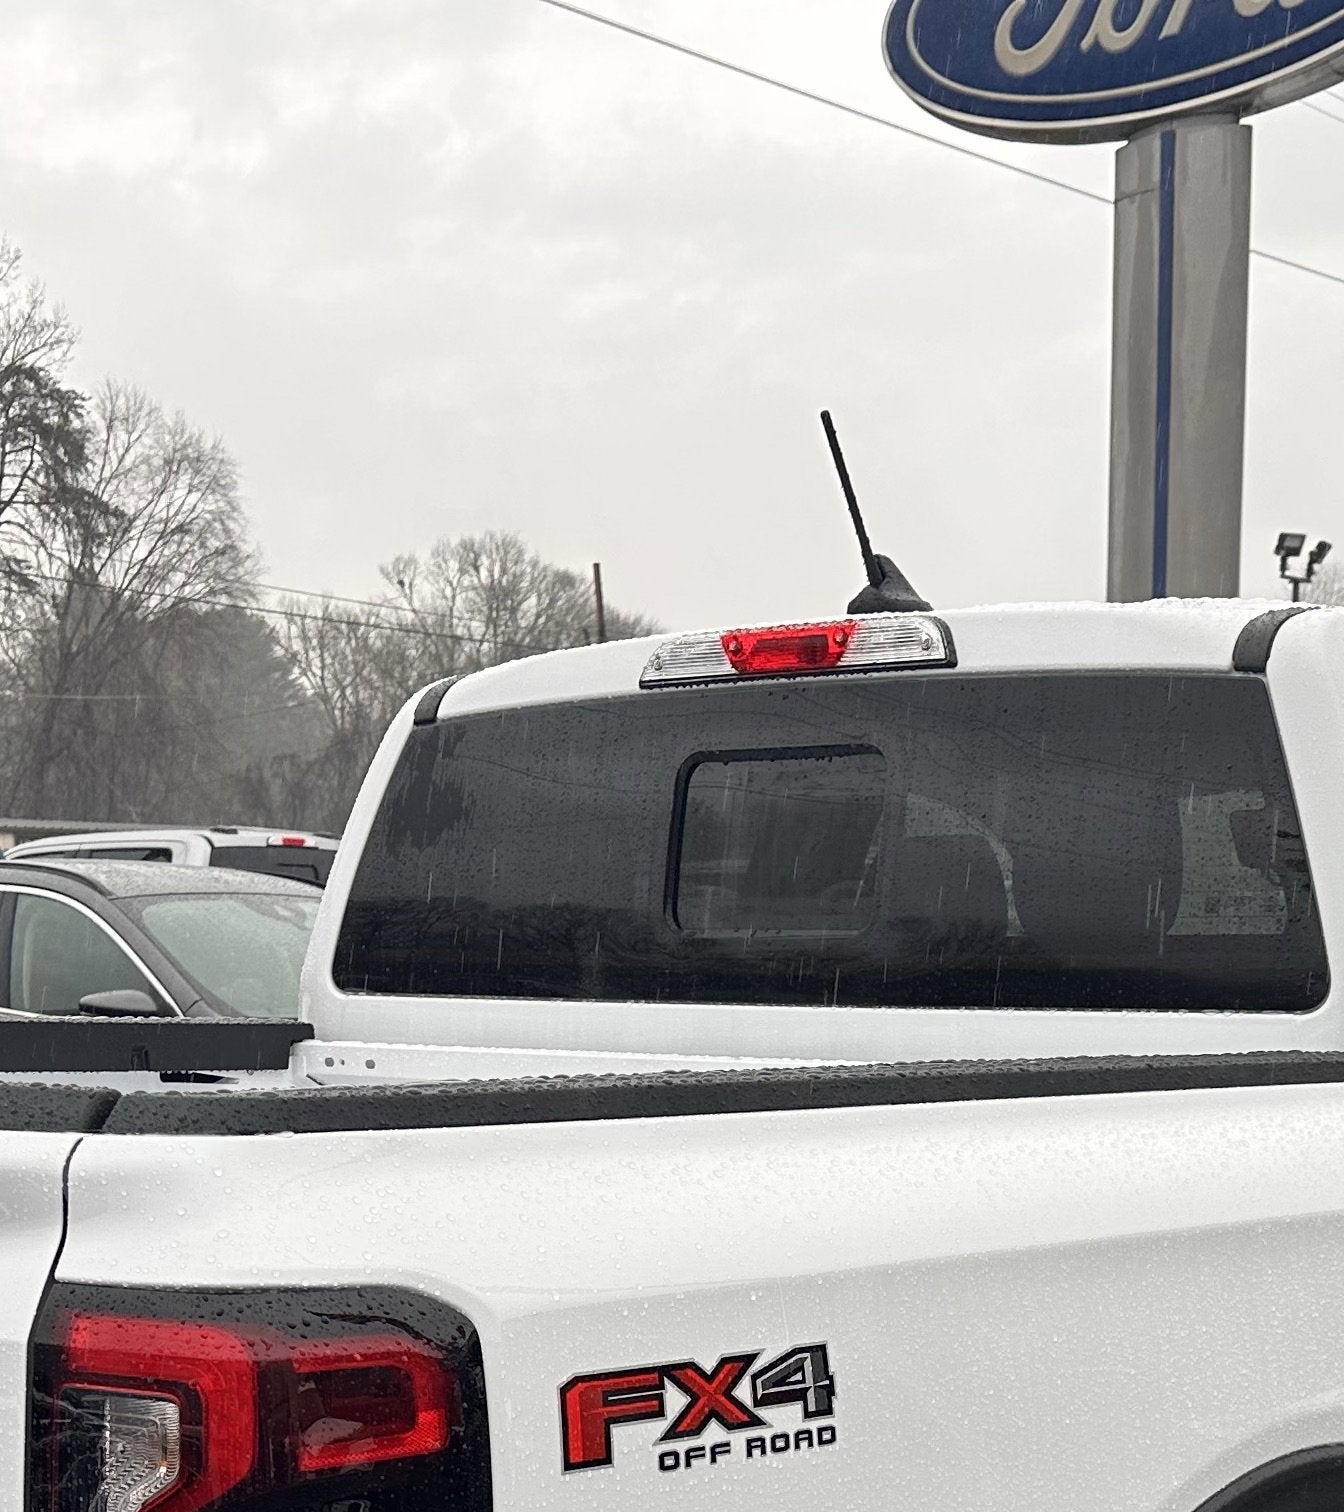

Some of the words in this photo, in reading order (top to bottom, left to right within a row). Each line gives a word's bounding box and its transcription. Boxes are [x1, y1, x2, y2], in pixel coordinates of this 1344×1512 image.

[557, 1341, 837, 1475] FX4
[658, 1440, 731, 1473] OFF
[746, 1425, 837, 1459] ROAD
